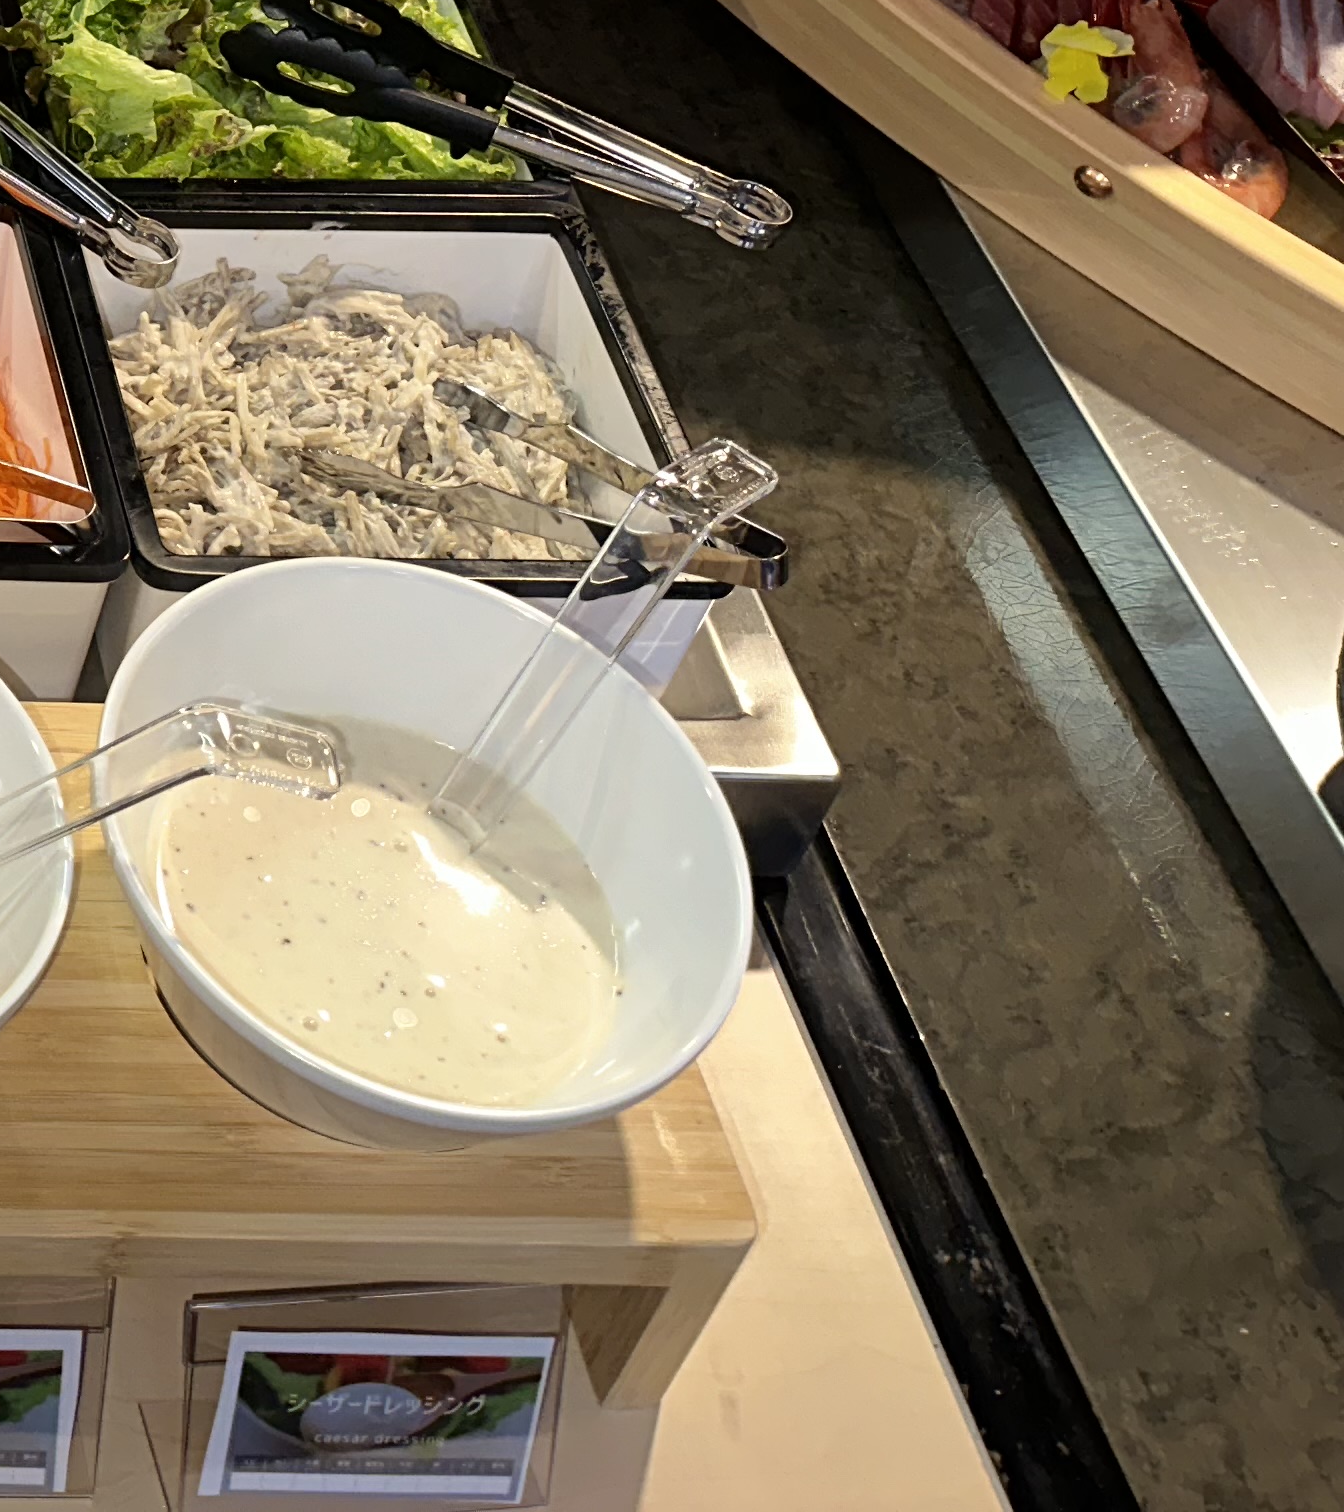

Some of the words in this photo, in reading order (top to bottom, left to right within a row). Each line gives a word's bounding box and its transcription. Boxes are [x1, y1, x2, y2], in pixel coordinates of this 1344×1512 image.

[287, 1393, 488, 1416] シーザードレッシング
[314, 1433, 369, 1445] caesar
